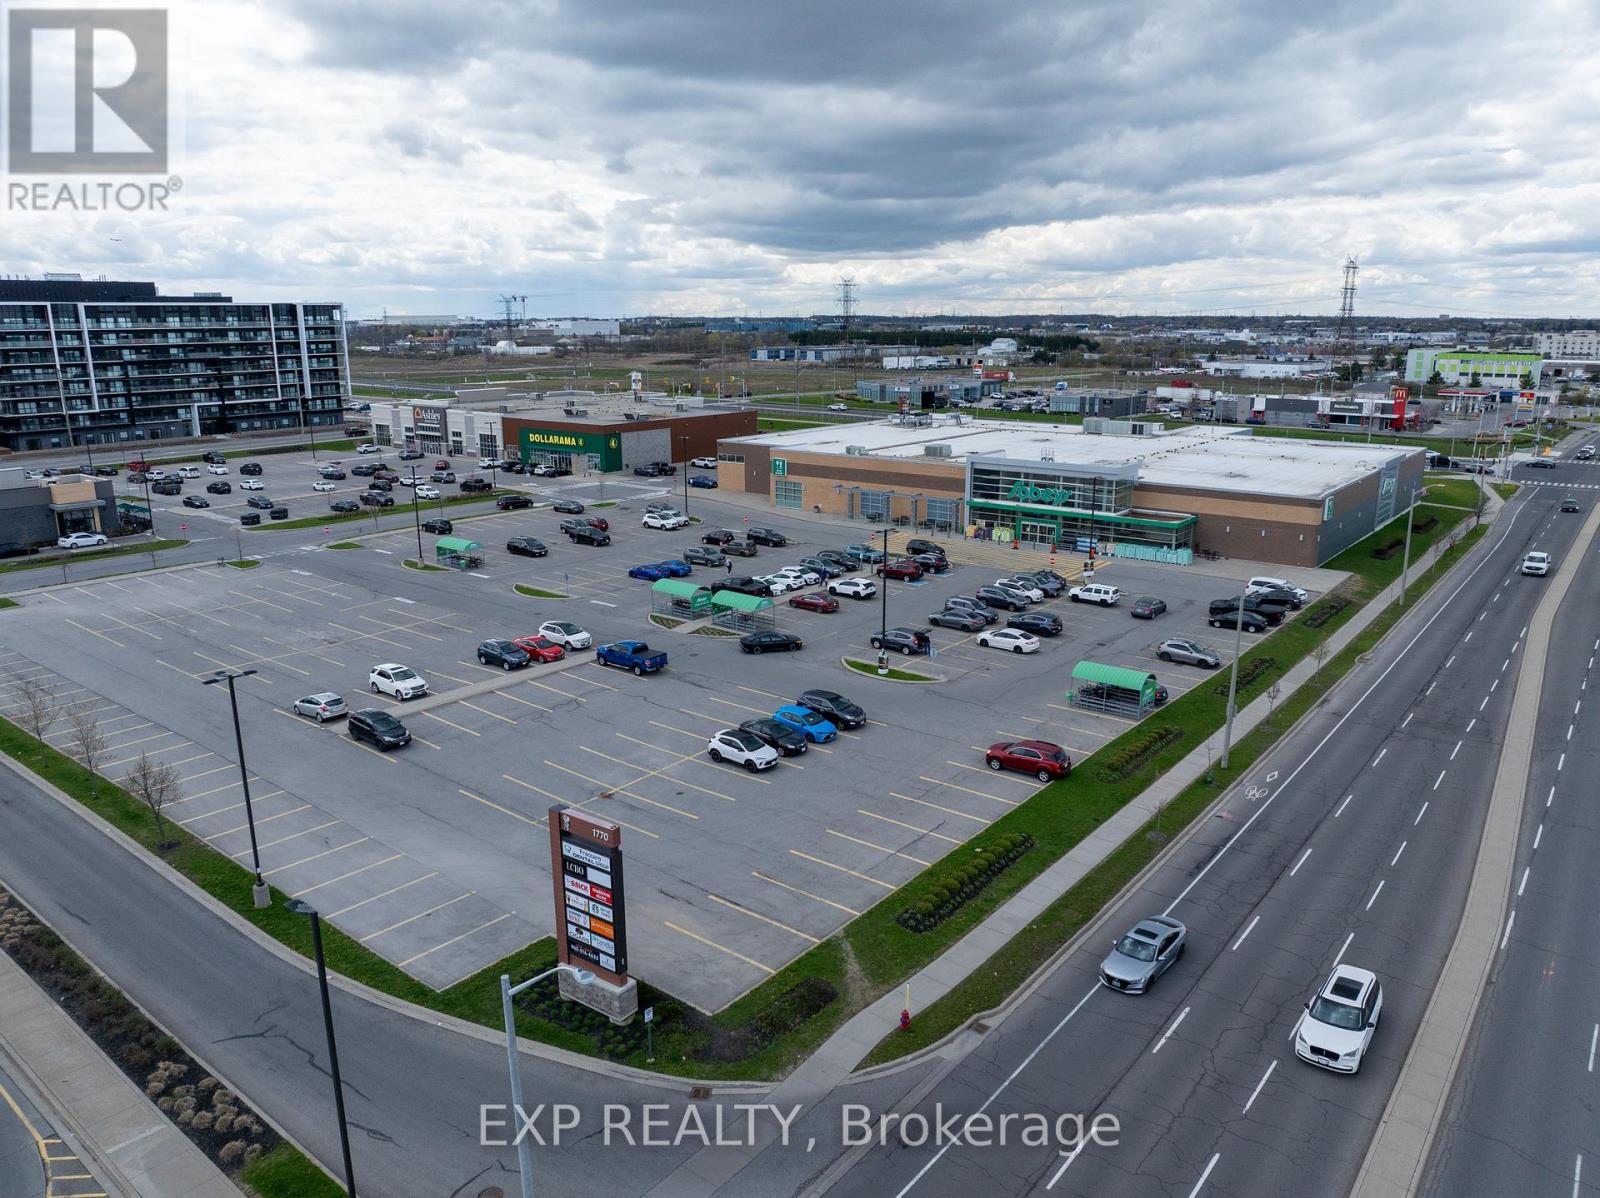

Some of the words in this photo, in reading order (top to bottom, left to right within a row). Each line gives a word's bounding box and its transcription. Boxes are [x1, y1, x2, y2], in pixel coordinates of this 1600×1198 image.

[422, 409, 441, 421] Ashley
[529, 433, 577, 446] DOLLARAMA
[1007, 479, 1073, 506] Sobeys
[592, 828, 609, 841] 1770
